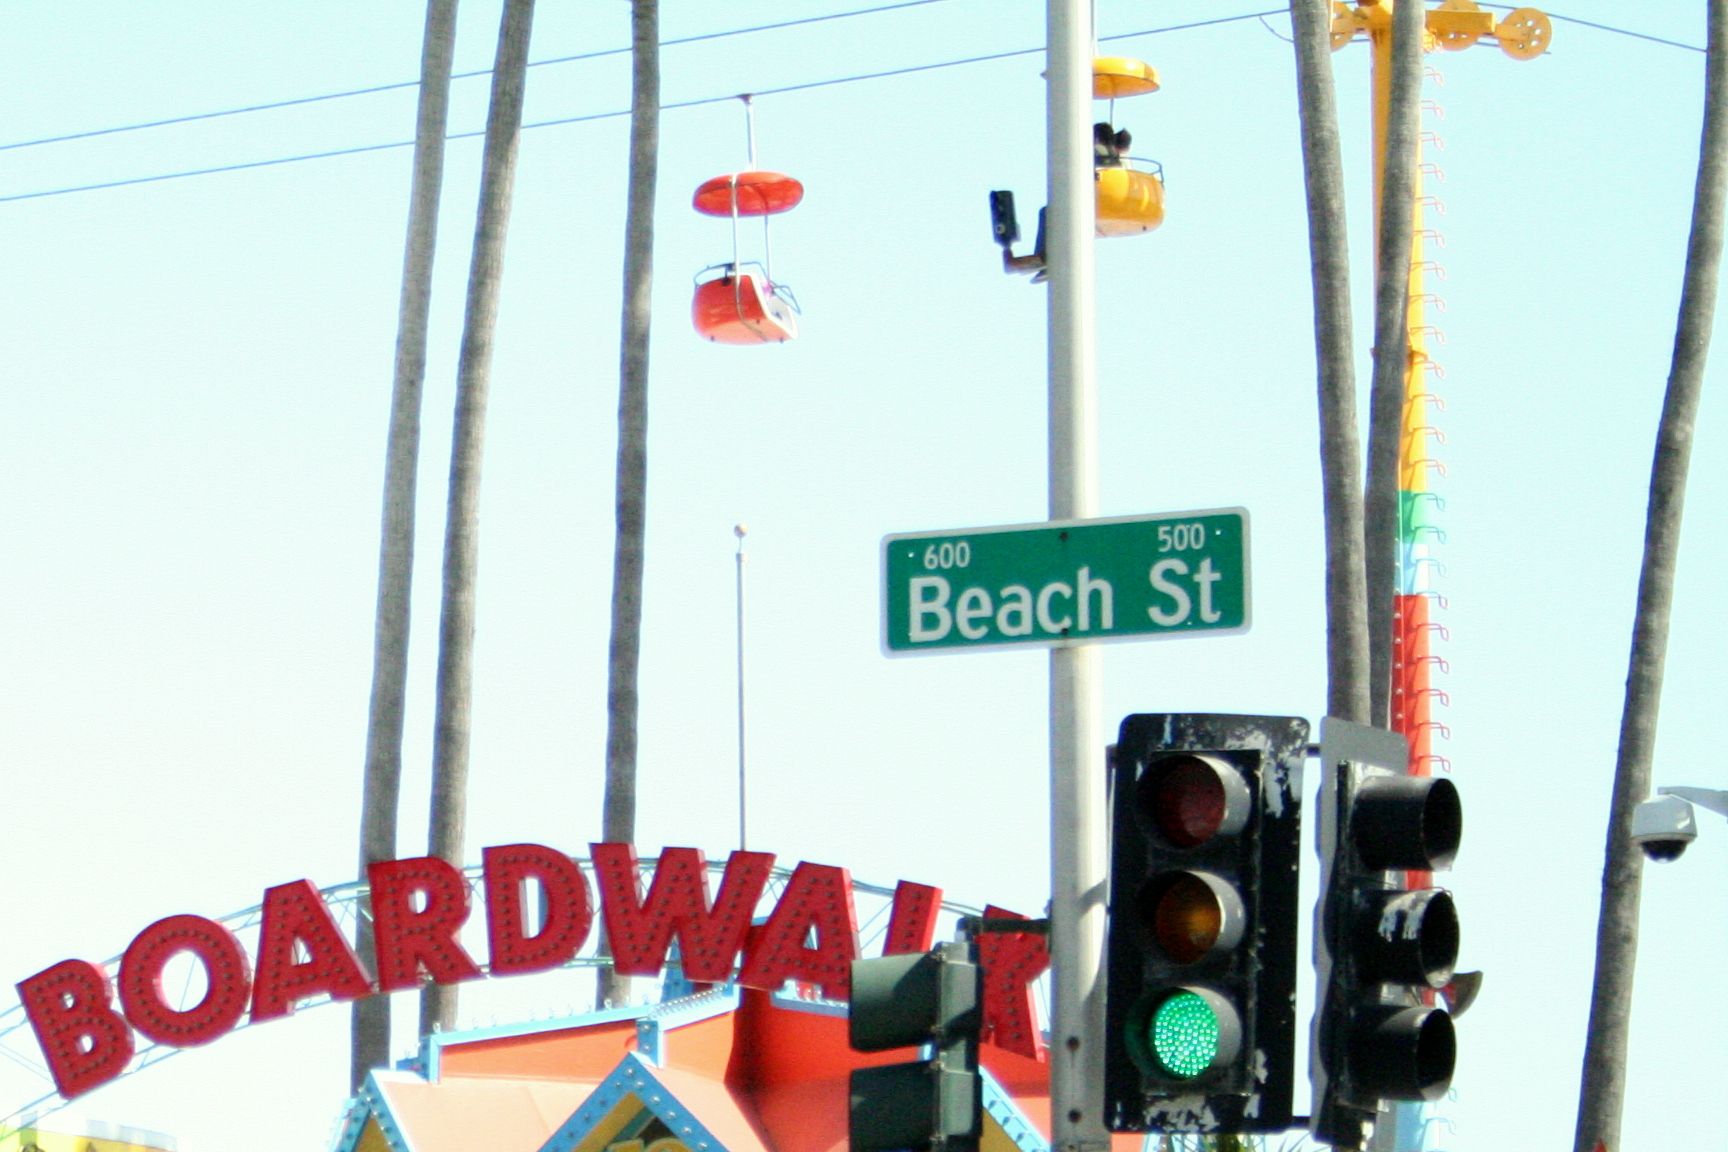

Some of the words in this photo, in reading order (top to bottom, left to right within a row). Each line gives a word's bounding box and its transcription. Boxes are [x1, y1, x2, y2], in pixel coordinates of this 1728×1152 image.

[1157, 523, 1206, 552] 500
[924, 541, 971, 570] 600
[908, 565, 1114, 644] Beach
[1147, 556, 1222, 627] St
